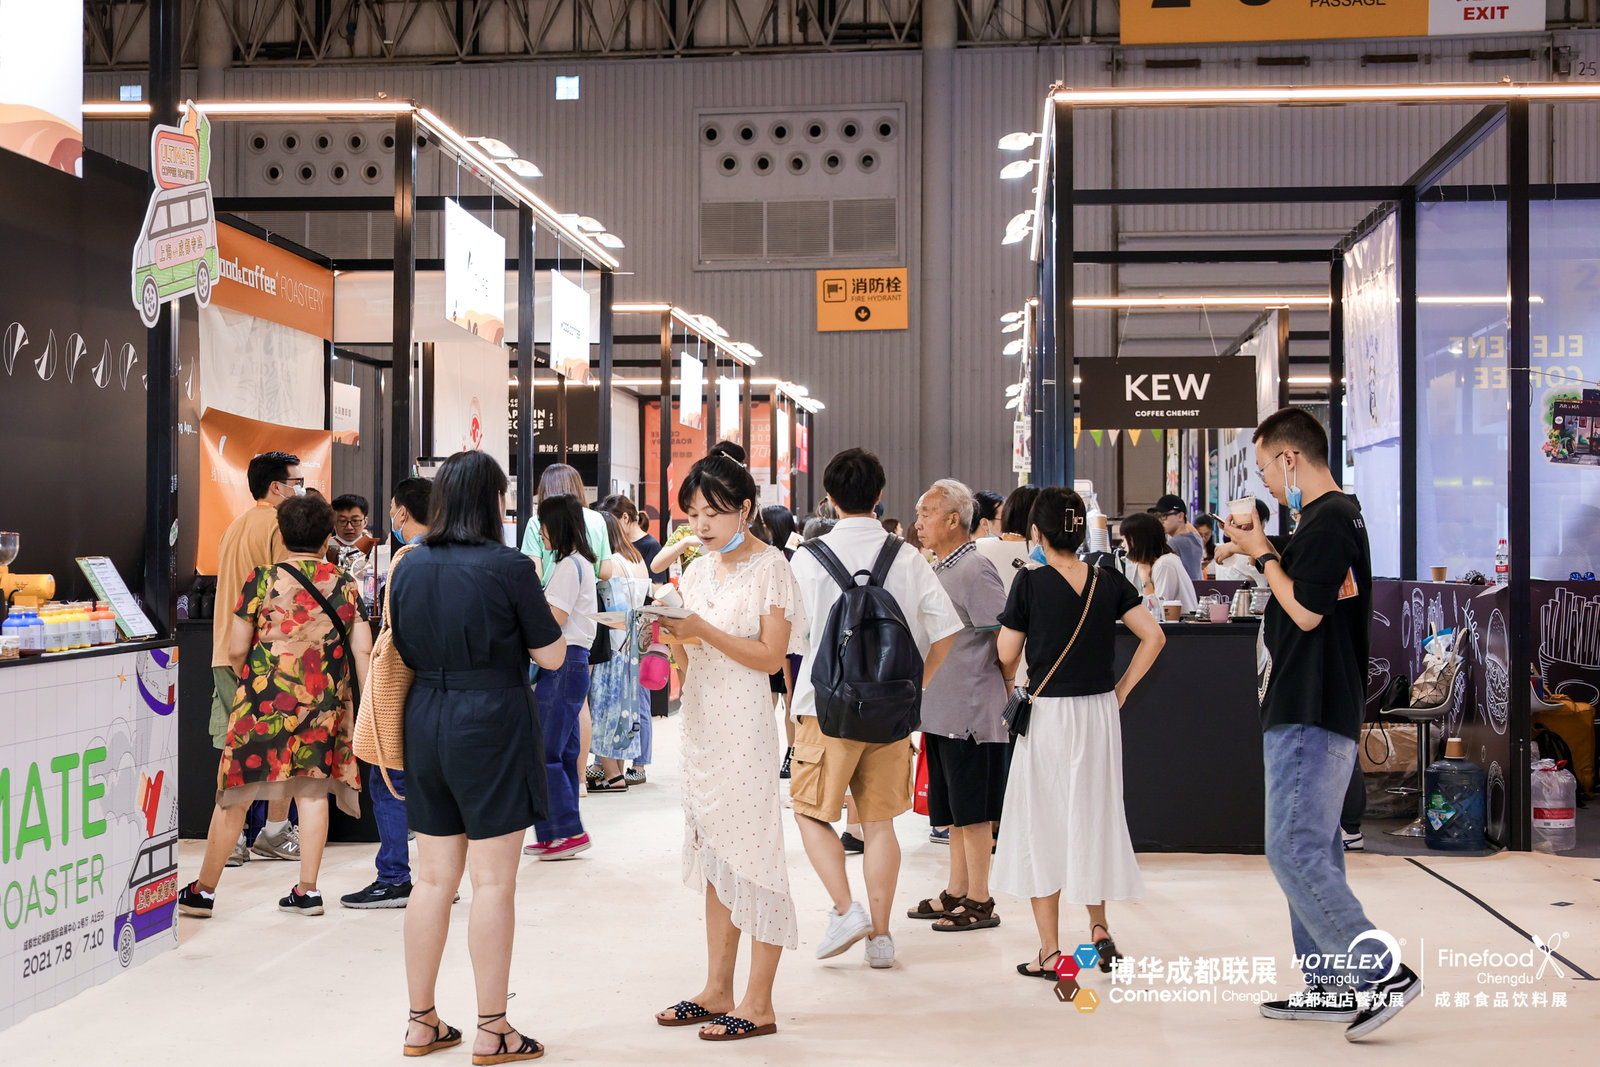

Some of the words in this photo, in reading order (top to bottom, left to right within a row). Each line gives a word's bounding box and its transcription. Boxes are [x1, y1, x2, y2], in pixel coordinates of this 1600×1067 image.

[1463, 6, 1509, 20] EXIT
[160, 143, 196, 168] ULTIMATE
[280, 275, 325, 313] ROASTERY
[851, 276, 902, 294] 消防栓
[867, 294, 902, 302] HYDRANT
[1125, 373, 1211, 401] KEW
[1165, 409, 1200, 417] CHEMIST
[0, 854, 104, 930] OASTER
[23, 949, 52, 978] 2021
[55, 941, 72, 965] 7.8
[83, 928, 104, 953] 7.10
